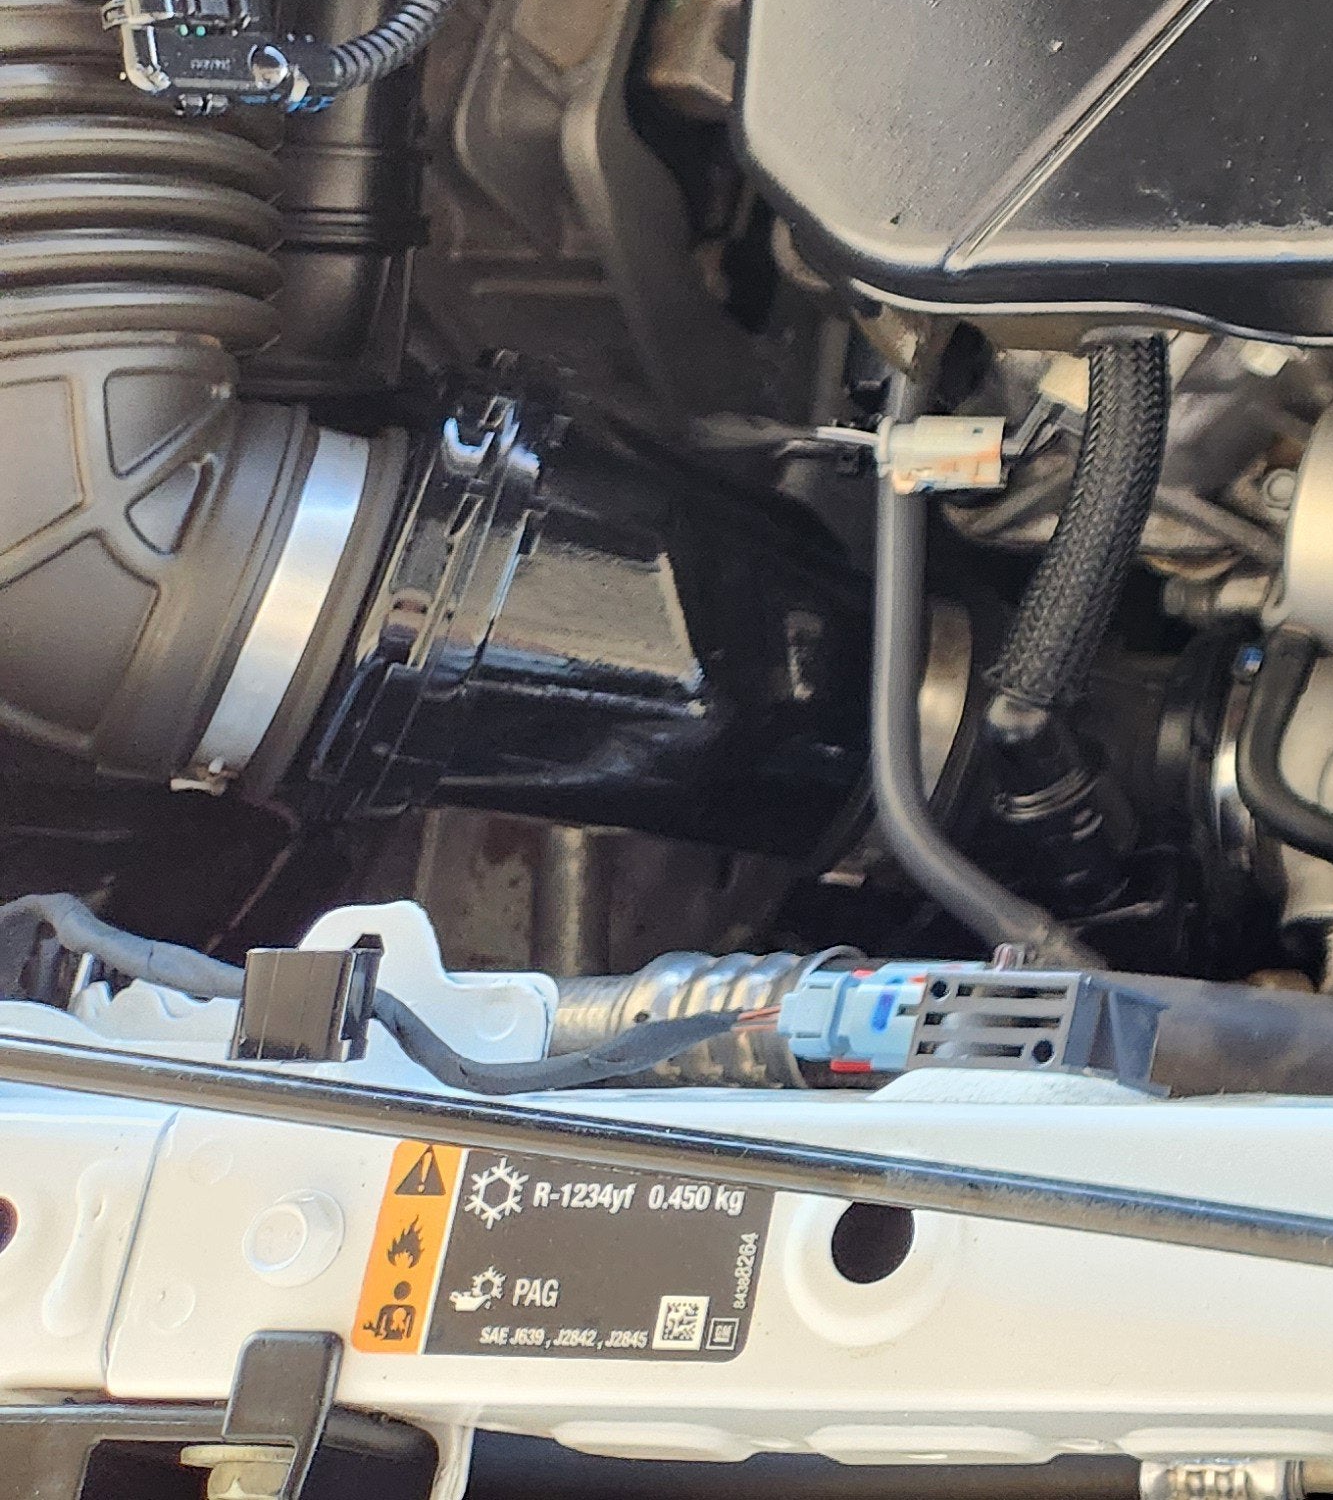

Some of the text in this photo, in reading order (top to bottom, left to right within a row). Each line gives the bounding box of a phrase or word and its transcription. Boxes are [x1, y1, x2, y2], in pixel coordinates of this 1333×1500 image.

[532, 1182, 745, 1216] R-1234yf 0.450 kg
[511, 1277, 560, 1309] PAG
[479, 1325, 510, 1346] SAE
[604, 1329, 649, 1349] J2845
